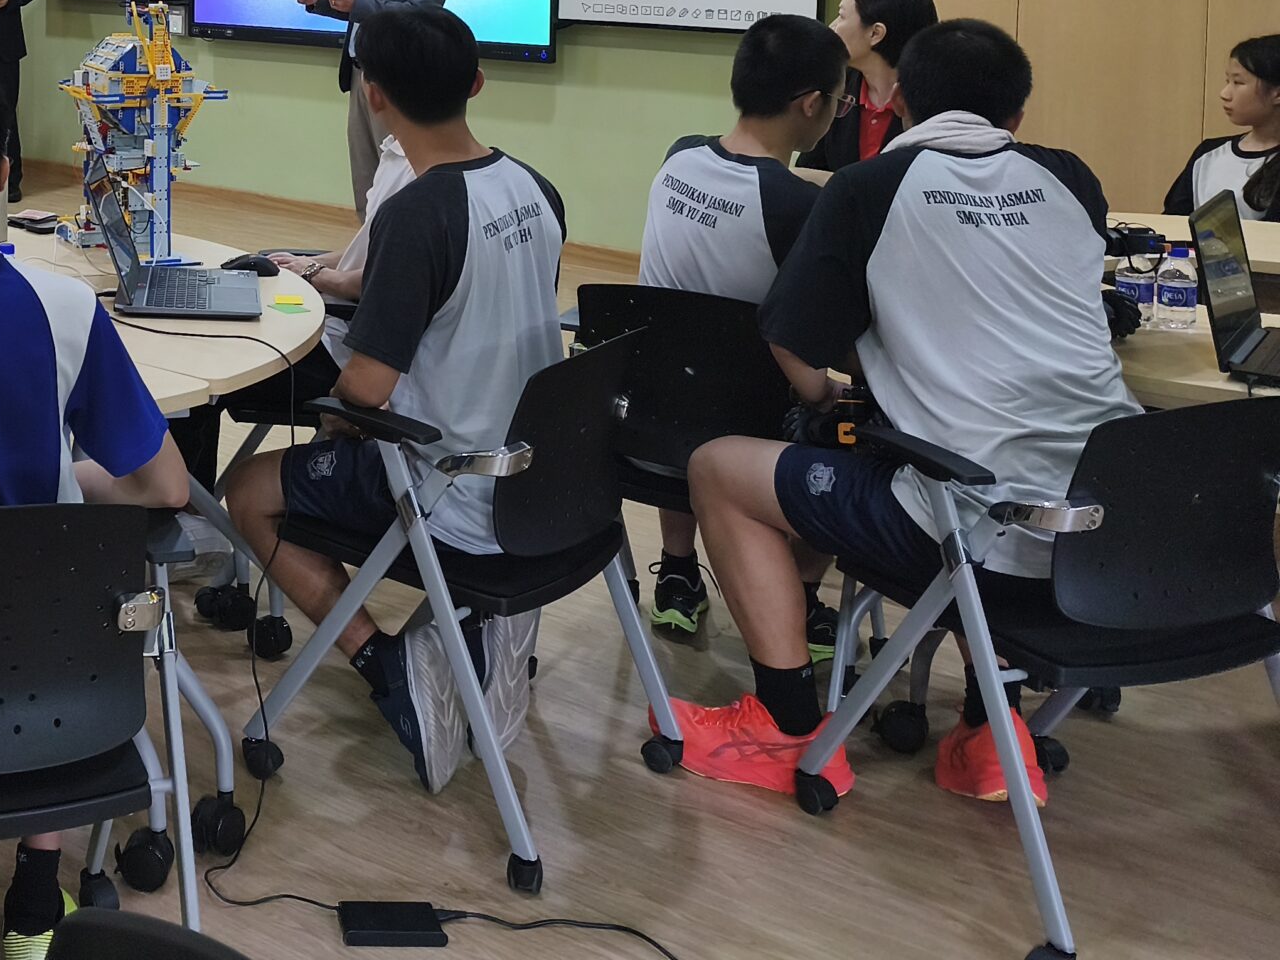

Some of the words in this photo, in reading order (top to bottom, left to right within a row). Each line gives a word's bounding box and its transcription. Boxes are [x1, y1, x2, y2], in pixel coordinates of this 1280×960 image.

[661, 173, 709, 205] PENDIDIKAN
[705, 193, 746, 218] JASMANI
[922, 190, 995, 209] PENDIDIKAN
[996, 188, 1046, 211] JASMANI
[665, 196, 685, 215] SMJK
[684, 203, 699, 221] YU
[698, 210, 719, 229] HUA
[955, 210, 984, 228] SMJK
[984, 212, 1001, 227] YU
[1000, 211, 1030, 227] HUA
